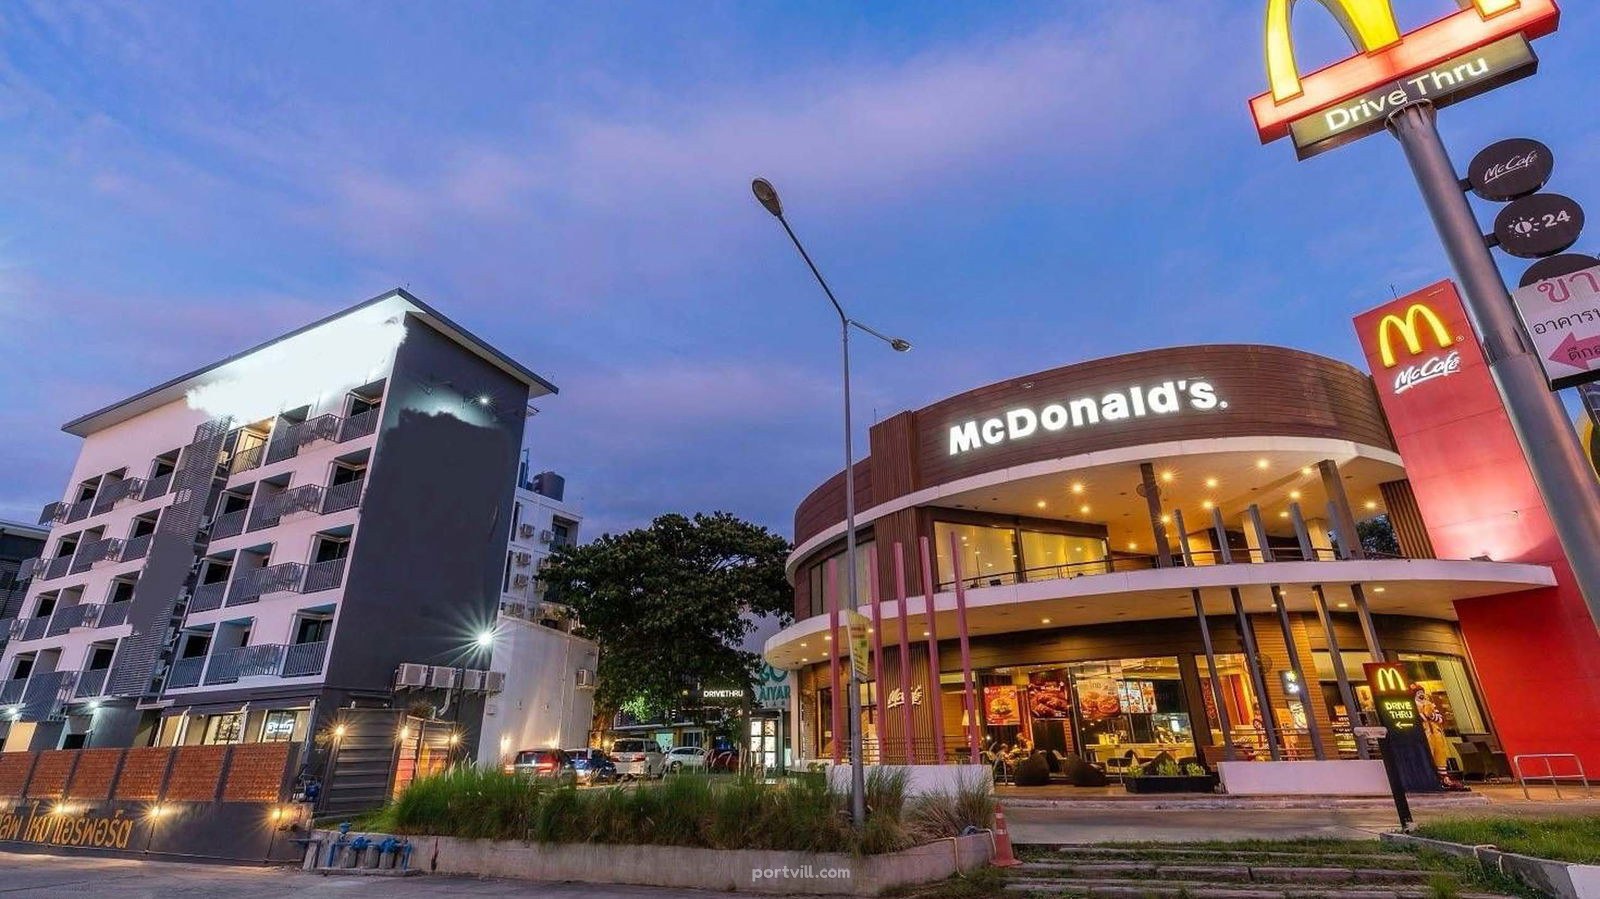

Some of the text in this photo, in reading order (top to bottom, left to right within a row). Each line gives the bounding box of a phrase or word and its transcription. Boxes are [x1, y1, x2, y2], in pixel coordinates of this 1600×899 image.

[1325, 57, 1489, 130] Drive Thru
[1541, 210, 1571, 228] 24
[1393, 351, 1462, 394] McCafé
[1384, 701, 1413, 711] DRIVE
[1389, 710, 1413, 719] THRU
